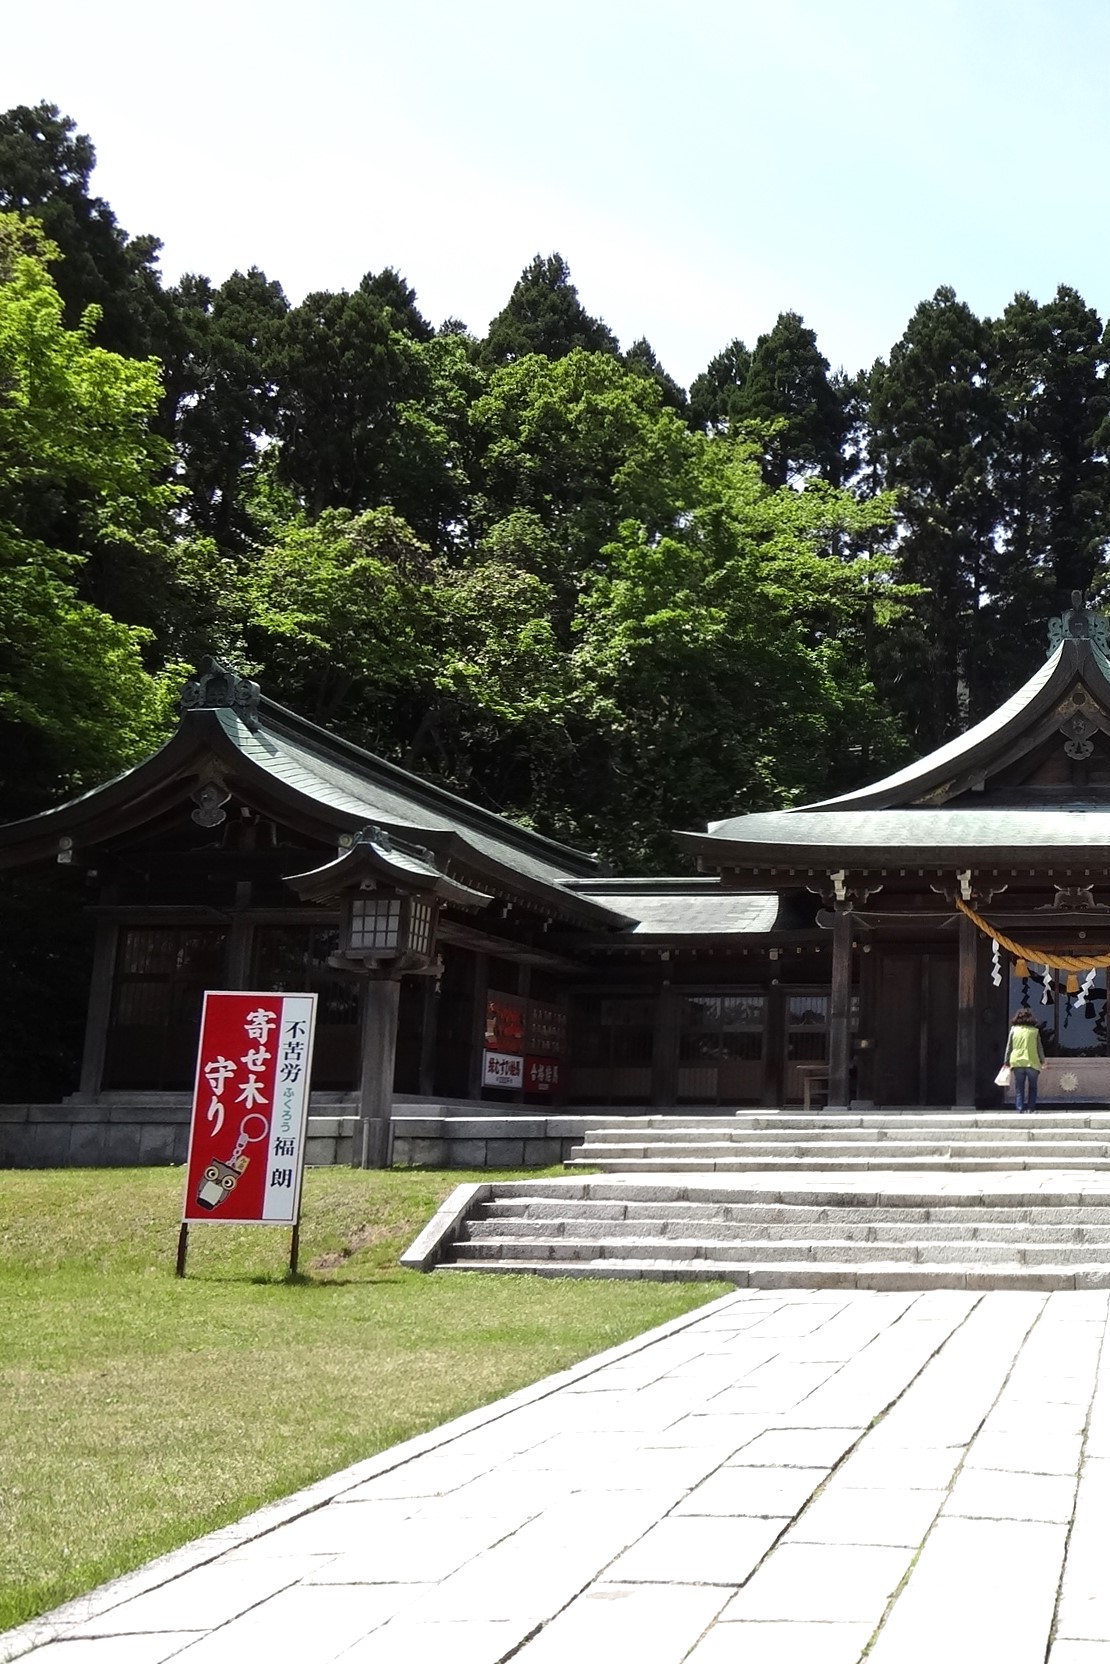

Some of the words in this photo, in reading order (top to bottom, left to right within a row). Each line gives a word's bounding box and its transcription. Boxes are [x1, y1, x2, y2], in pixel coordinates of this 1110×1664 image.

[204, 1056, 237, 1137] 守り
[234, 1008, 277, 1109] 寄せ木
